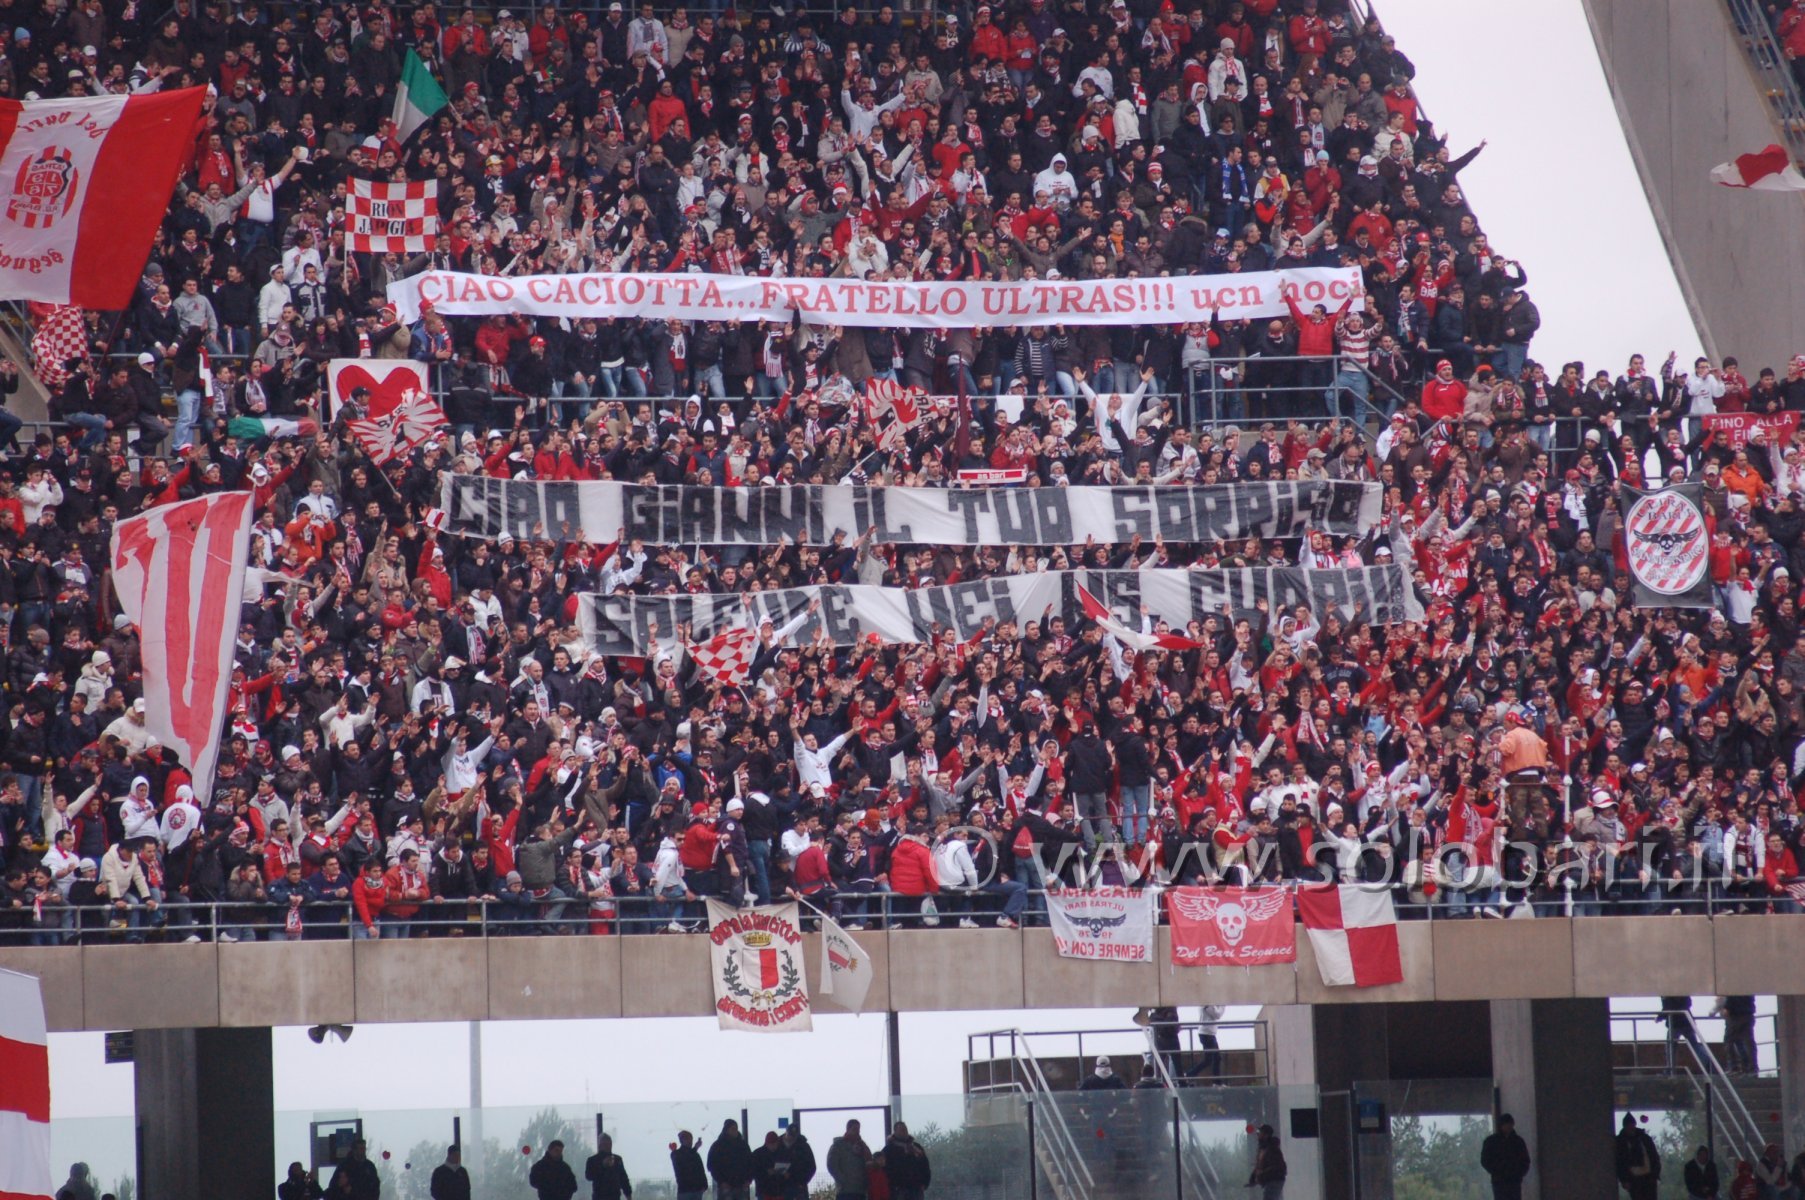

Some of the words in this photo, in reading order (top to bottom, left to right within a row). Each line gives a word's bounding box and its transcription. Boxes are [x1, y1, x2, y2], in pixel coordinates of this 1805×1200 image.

[417, 276, 514, 304] CIAO
[982, 283, 1175, 315] ULTRAS!!!
[1191, 284, 1263, 310] ucn
[1279, 271, 1364, 304] noci
[1712, 416, 1744, 429] FINO
[1756, 413, 1793, 427] ALLA
[948, 488, 1074, 544] TUO
[1176, 946, 1200, 958] Del
[1204, 945, 1235, 958] Bari
[1239, 945, 1293, 961] Seguaci
